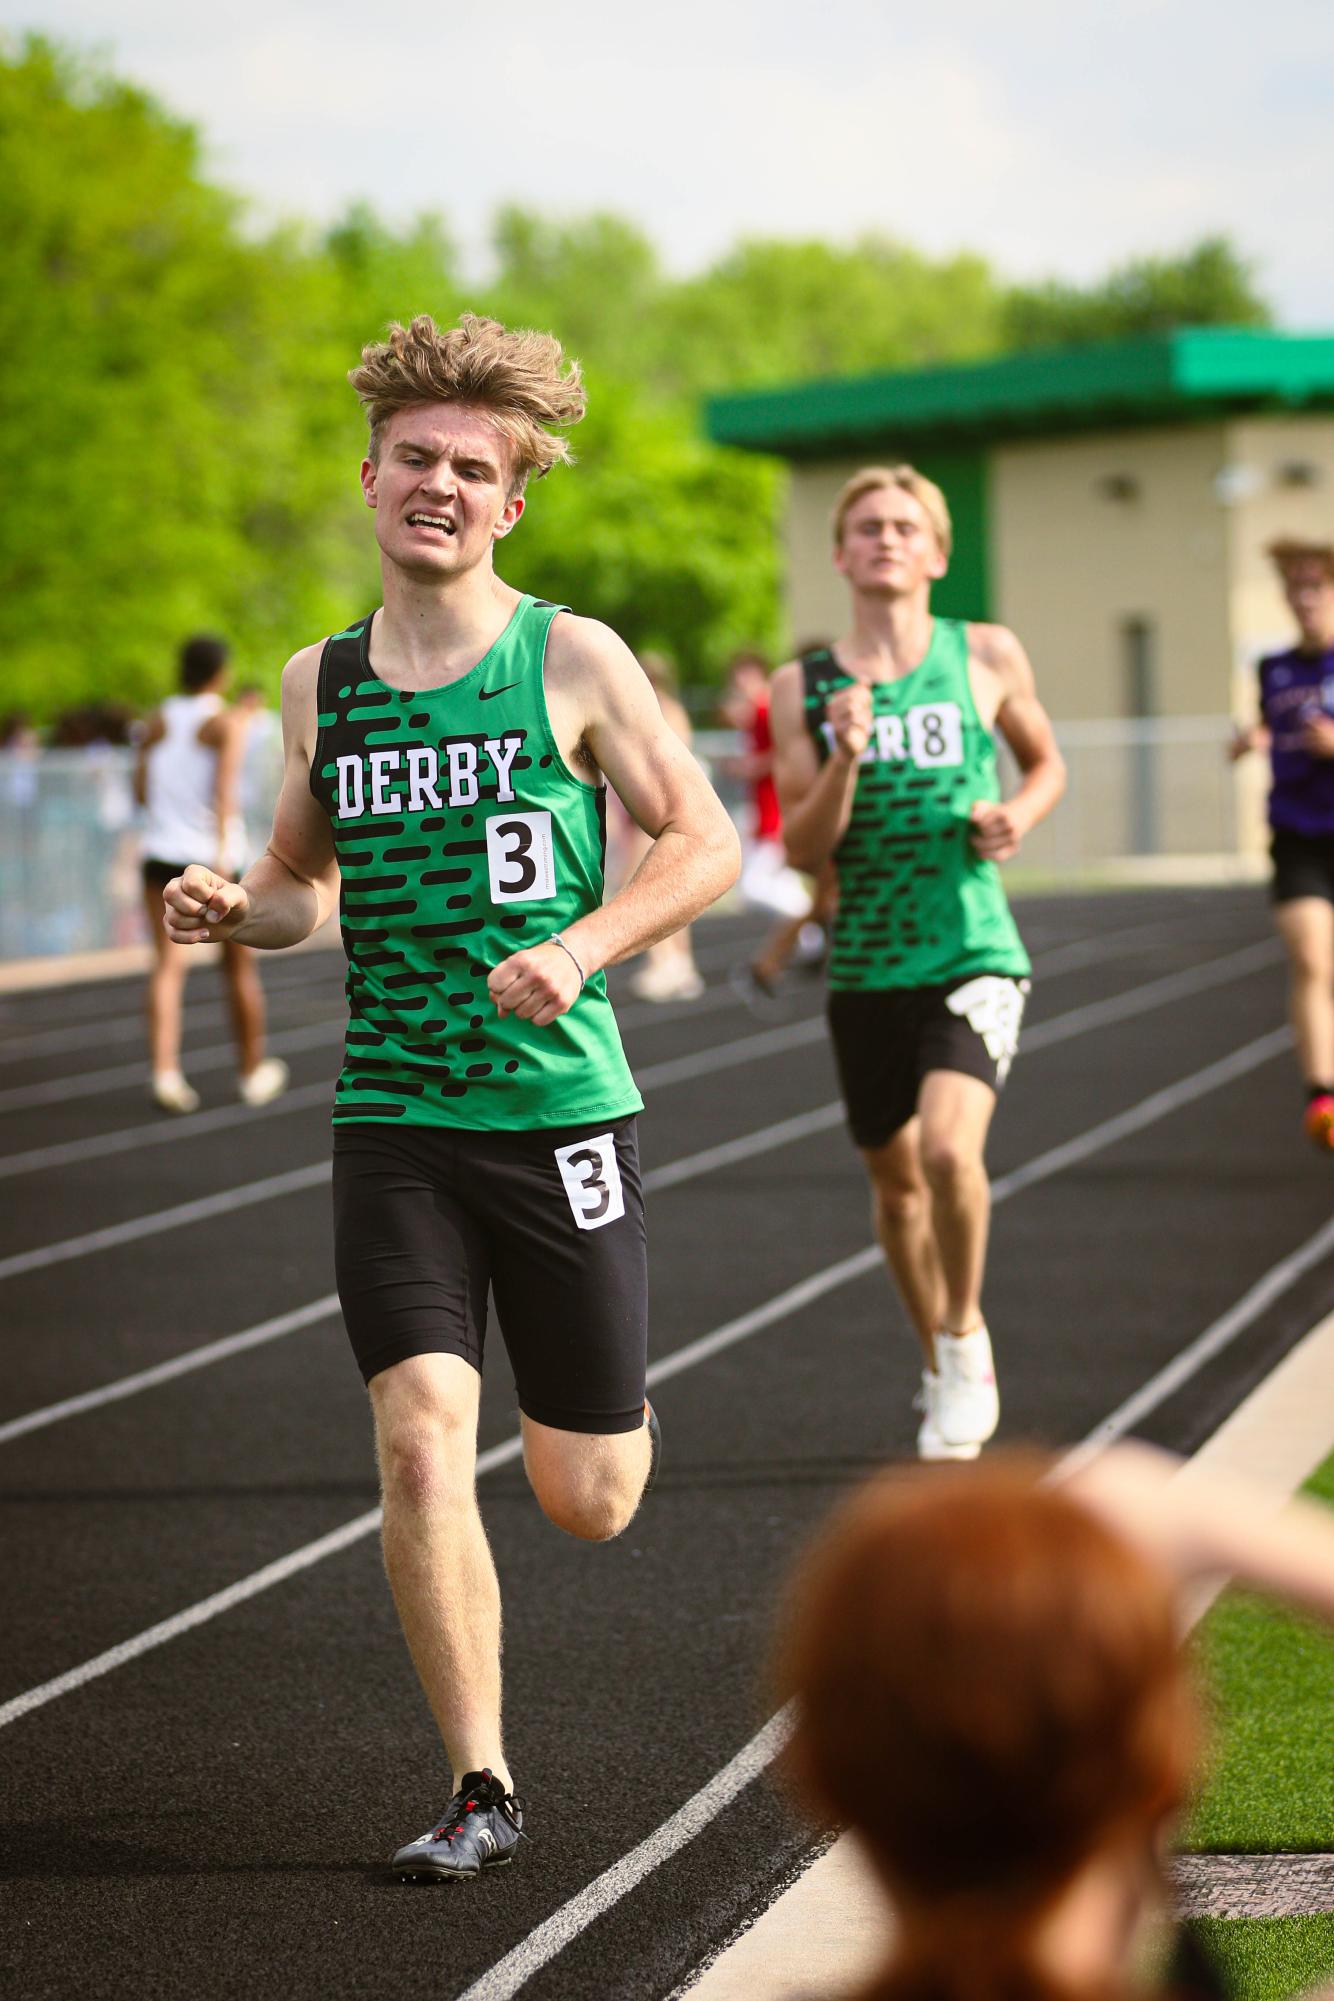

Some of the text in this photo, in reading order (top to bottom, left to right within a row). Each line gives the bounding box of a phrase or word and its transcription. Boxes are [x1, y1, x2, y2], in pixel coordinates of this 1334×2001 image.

[922, 712, 946, 757] 8
[335, 737, 523, 820] DERBY
[495, 820, 537, 894] 3
[566, 1148, 610, 1220] 3
